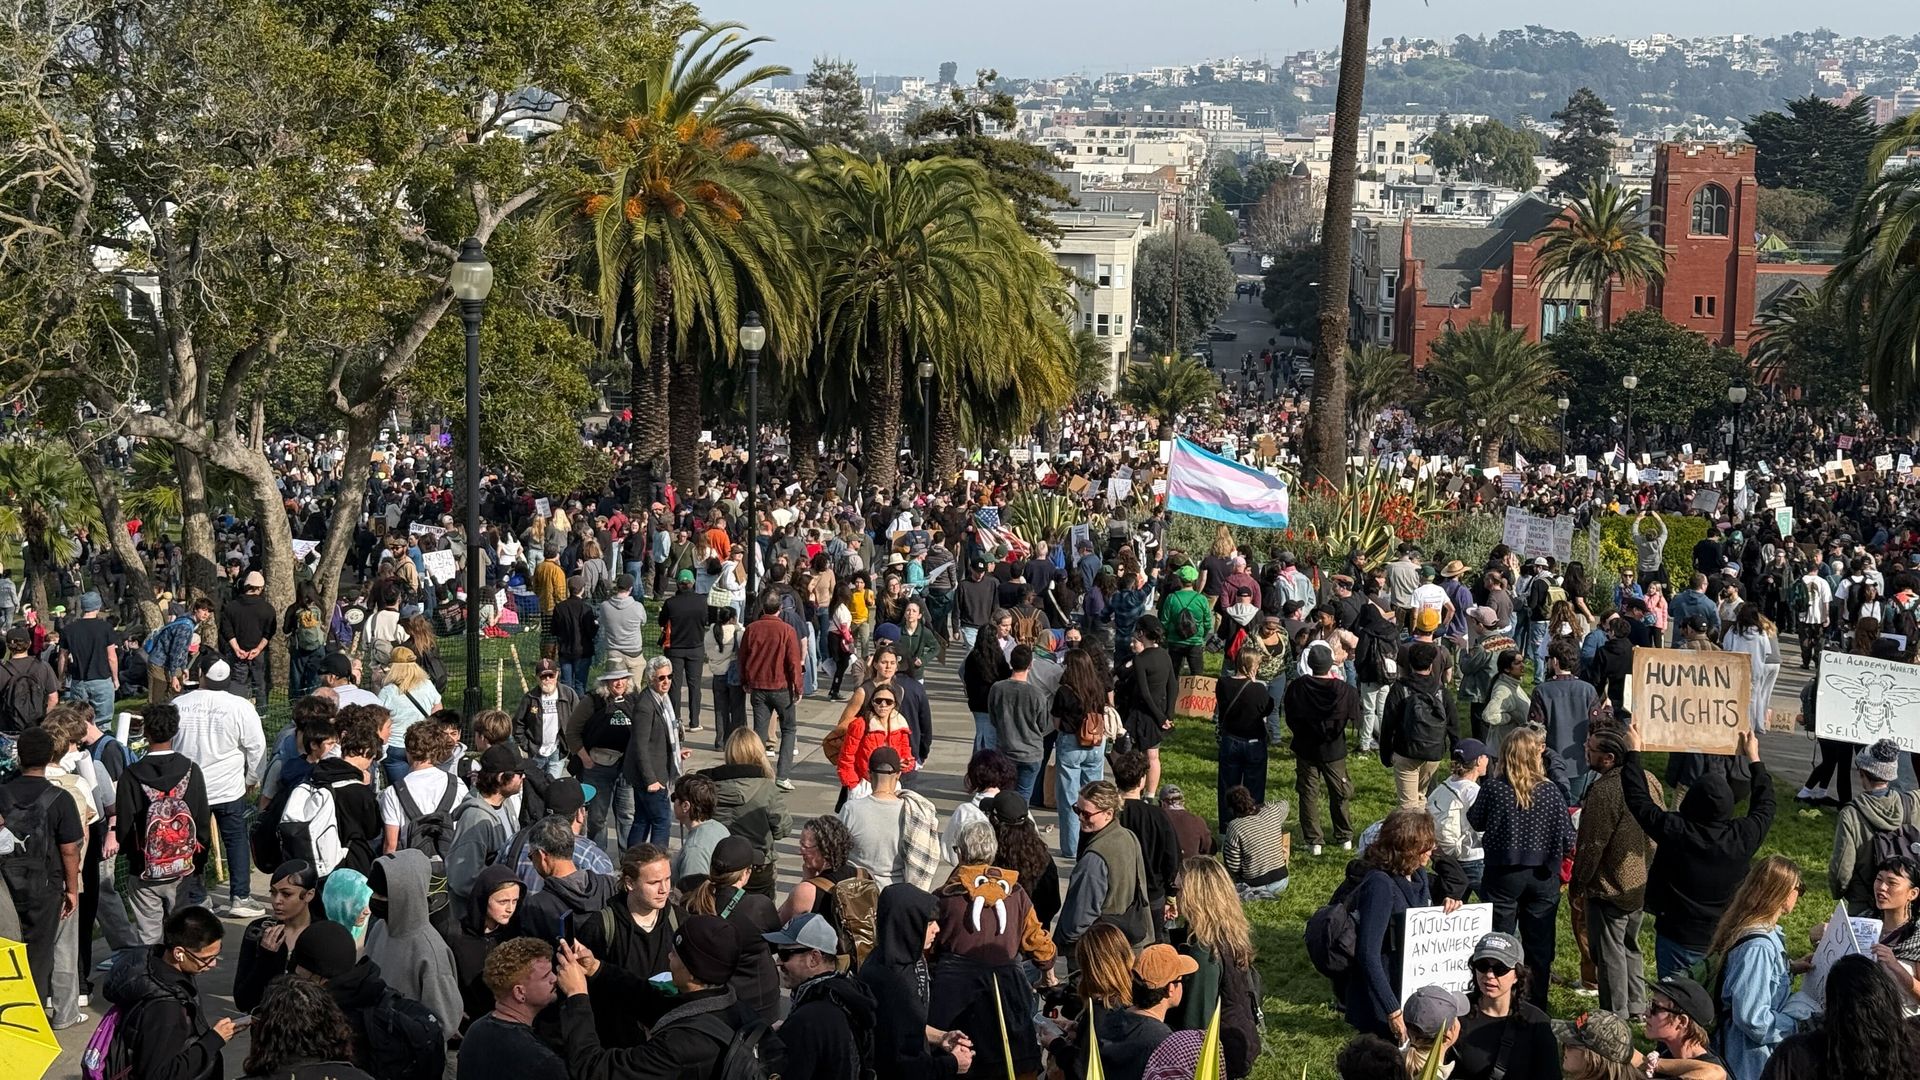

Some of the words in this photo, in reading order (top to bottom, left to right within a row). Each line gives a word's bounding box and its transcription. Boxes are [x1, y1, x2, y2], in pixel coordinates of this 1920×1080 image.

[1645, 662, 1731, 689] HUMAN
[1847, 656, 1887, 671] ACADEMY
[1890, 662, 1918, 676] WORKERS
[1184, 677, 1210, 691] FUCK
[1650, 694, 1740, 727] RIGHTS
[1411, 915, 1480, 937] INJUSTICE
[1412, 934, 1479, 957] ANYWHERE
[1413, 963, 1426, 976] IS
[1443, 958, 1469, 972] THRE
